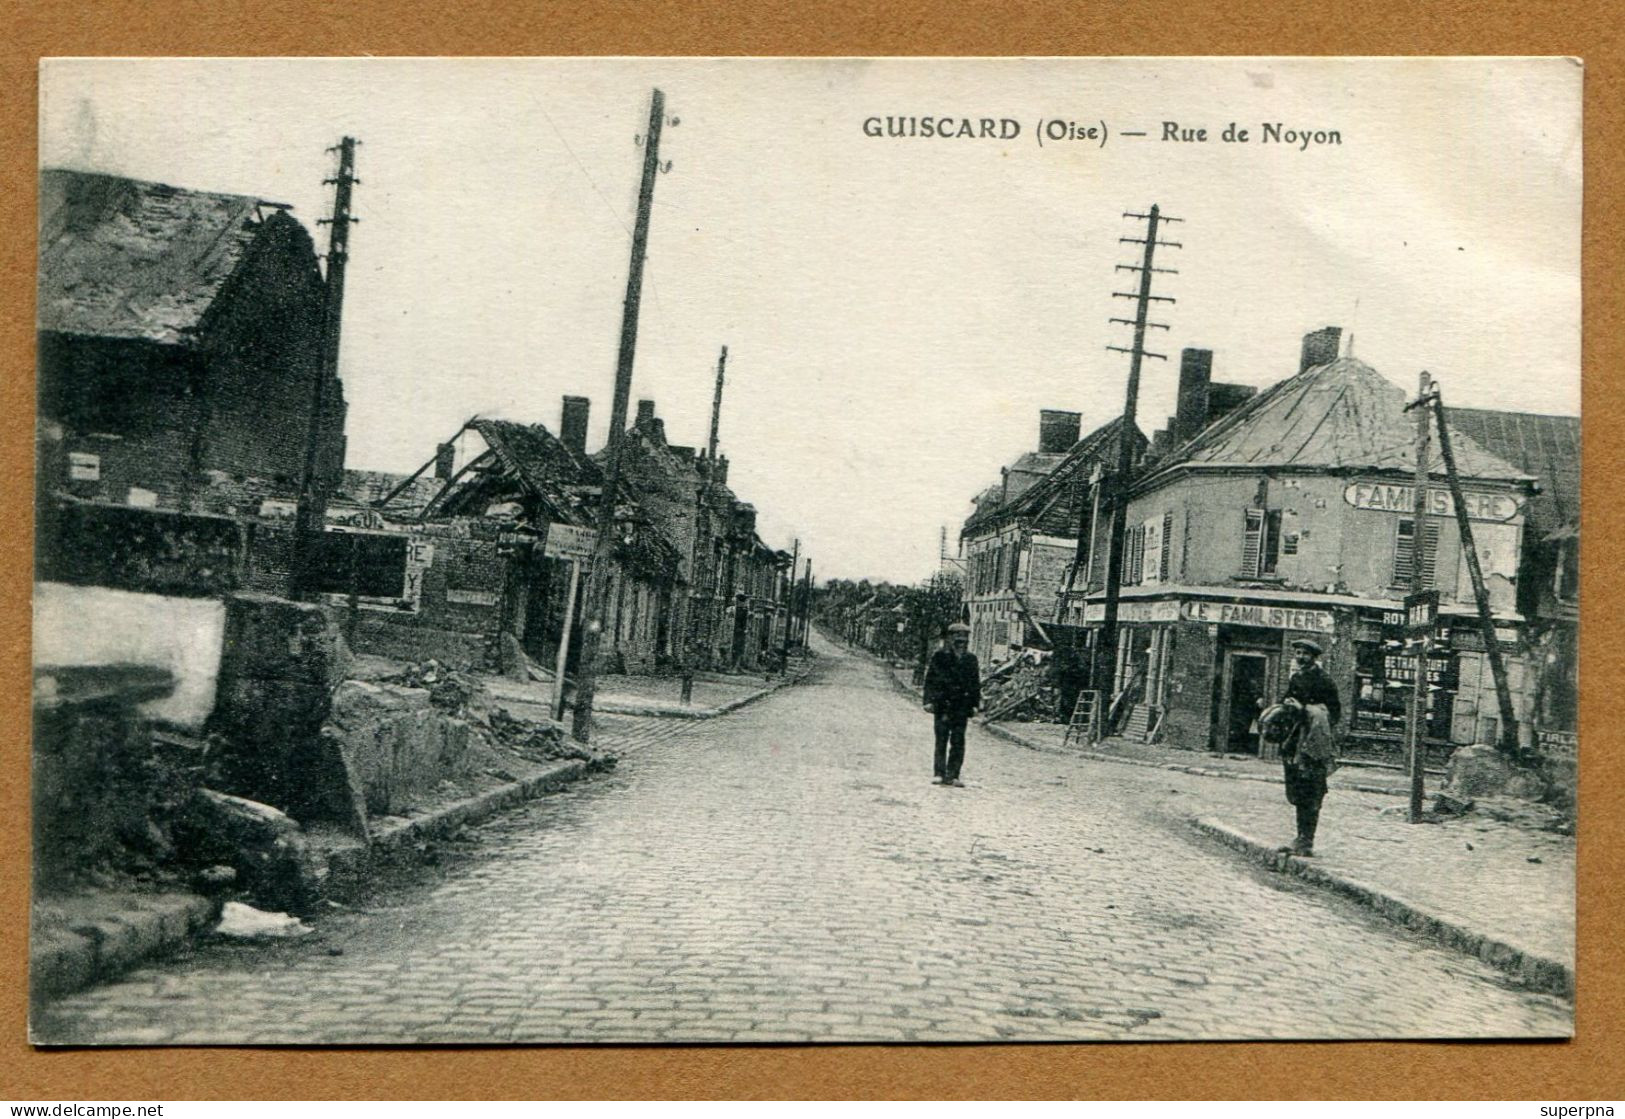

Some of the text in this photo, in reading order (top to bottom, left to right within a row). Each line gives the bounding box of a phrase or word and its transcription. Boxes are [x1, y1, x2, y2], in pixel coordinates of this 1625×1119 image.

[1353, 483, 1506, 517] FAMIISERE
[1187, 602, 1208, 621] LE
[1219, 604, 1331, 630] FAMILISTERE
